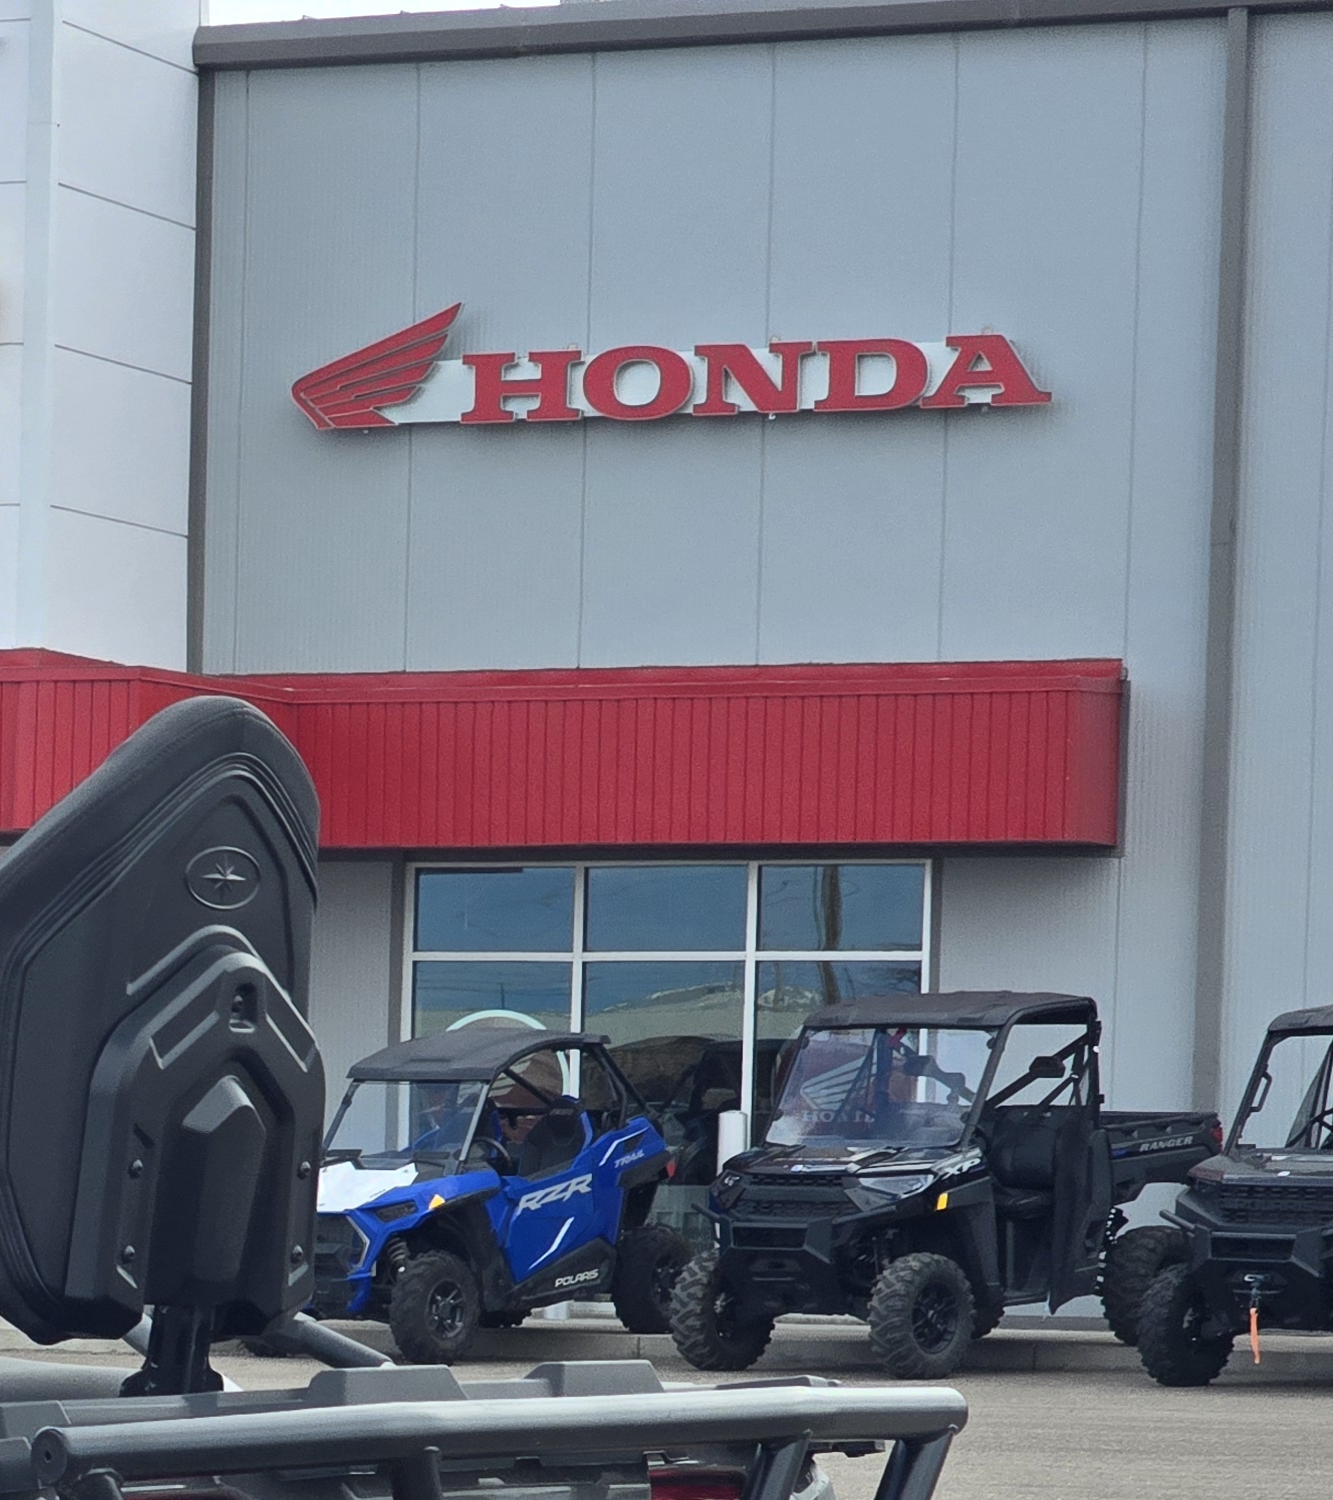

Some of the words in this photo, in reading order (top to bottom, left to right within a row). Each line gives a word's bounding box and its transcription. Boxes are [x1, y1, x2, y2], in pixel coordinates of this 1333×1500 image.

[459, 333, 1053, 425] HONDA
[1139, 1136, 1193, 1152] RANGER
[941, 1157, 981, 1180] XP
[515, 1173, 593, 1216] RZR
[554, 1268, 599, 1287] POLARIS
